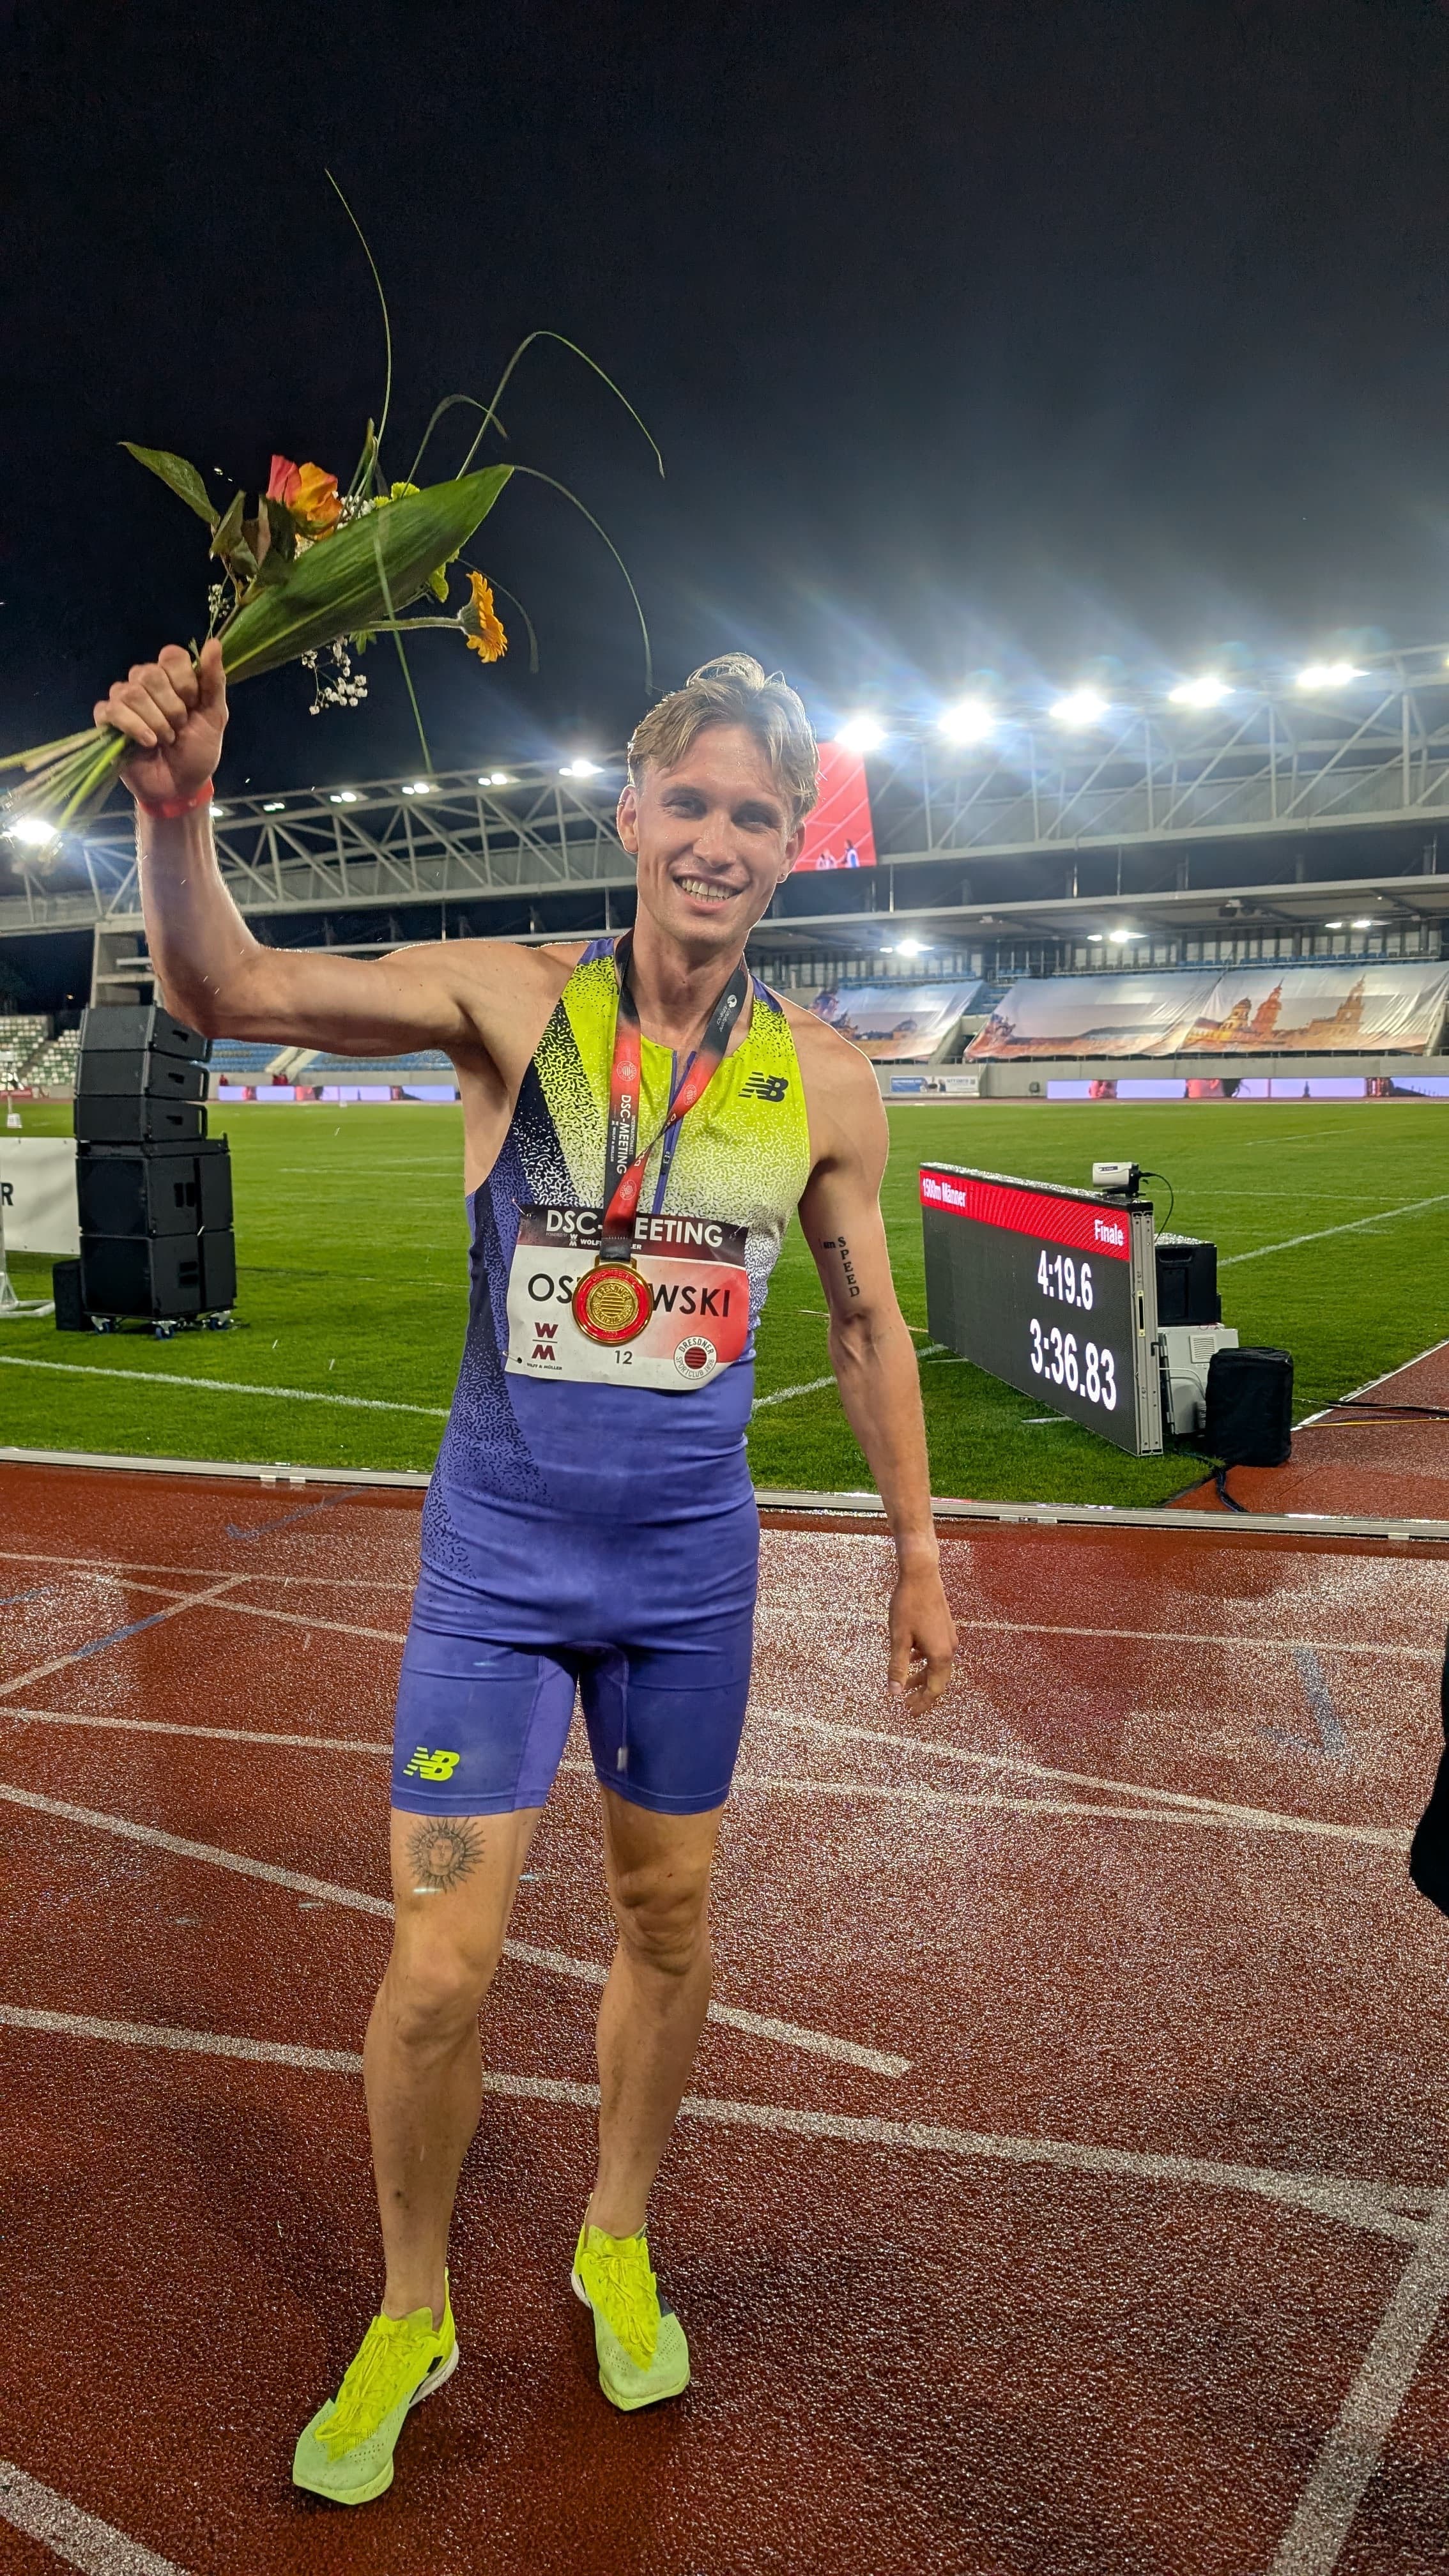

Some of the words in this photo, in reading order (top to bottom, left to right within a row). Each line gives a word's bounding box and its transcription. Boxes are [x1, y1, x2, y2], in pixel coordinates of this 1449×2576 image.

[616, 1094, 632, 1174] DSC-MEETING
[923, 1177, 942, 1200] 1500m
[942, 1182, 967, 1208] Männer
[546, 1209, 723, 1247] DSC-EETING
[1094, 1219, 1124, 1246] Finale
[838, 1236, 860, 1298] SPEED
[1038, 1250, 1092, 1310] 4:19.6
[528, 1273, 730, 1317] OSWSKI
[535, 1322, 558, 1338] W
[678, 1338, 714, 1354] DRESDNER
[532, 1344, 555, 1361] M
[615, 1350, 632, 1365] 12
[676, 1356, 704, 1377] SPORTCLUB
[1029, 1318, 1117, 1410] 3:36.83
[402, 1746, 460, 1782] NB
